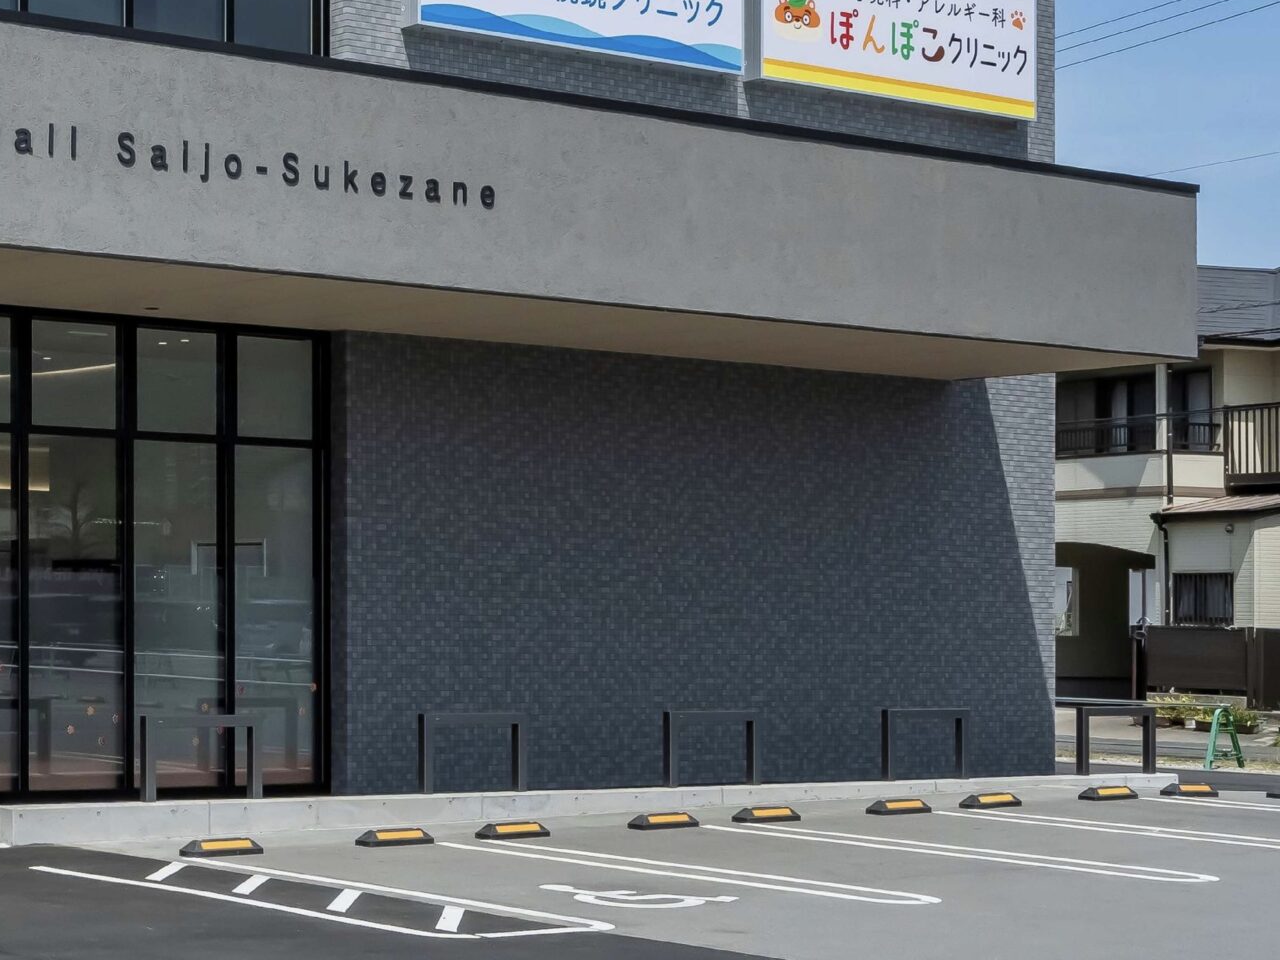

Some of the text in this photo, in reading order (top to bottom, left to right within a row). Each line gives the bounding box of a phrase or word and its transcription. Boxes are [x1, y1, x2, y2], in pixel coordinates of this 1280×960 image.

[829, 8, 1028, 76] ぽんぽこクリニック
[116, 131, 496, 210] Saijo-Sukezane
